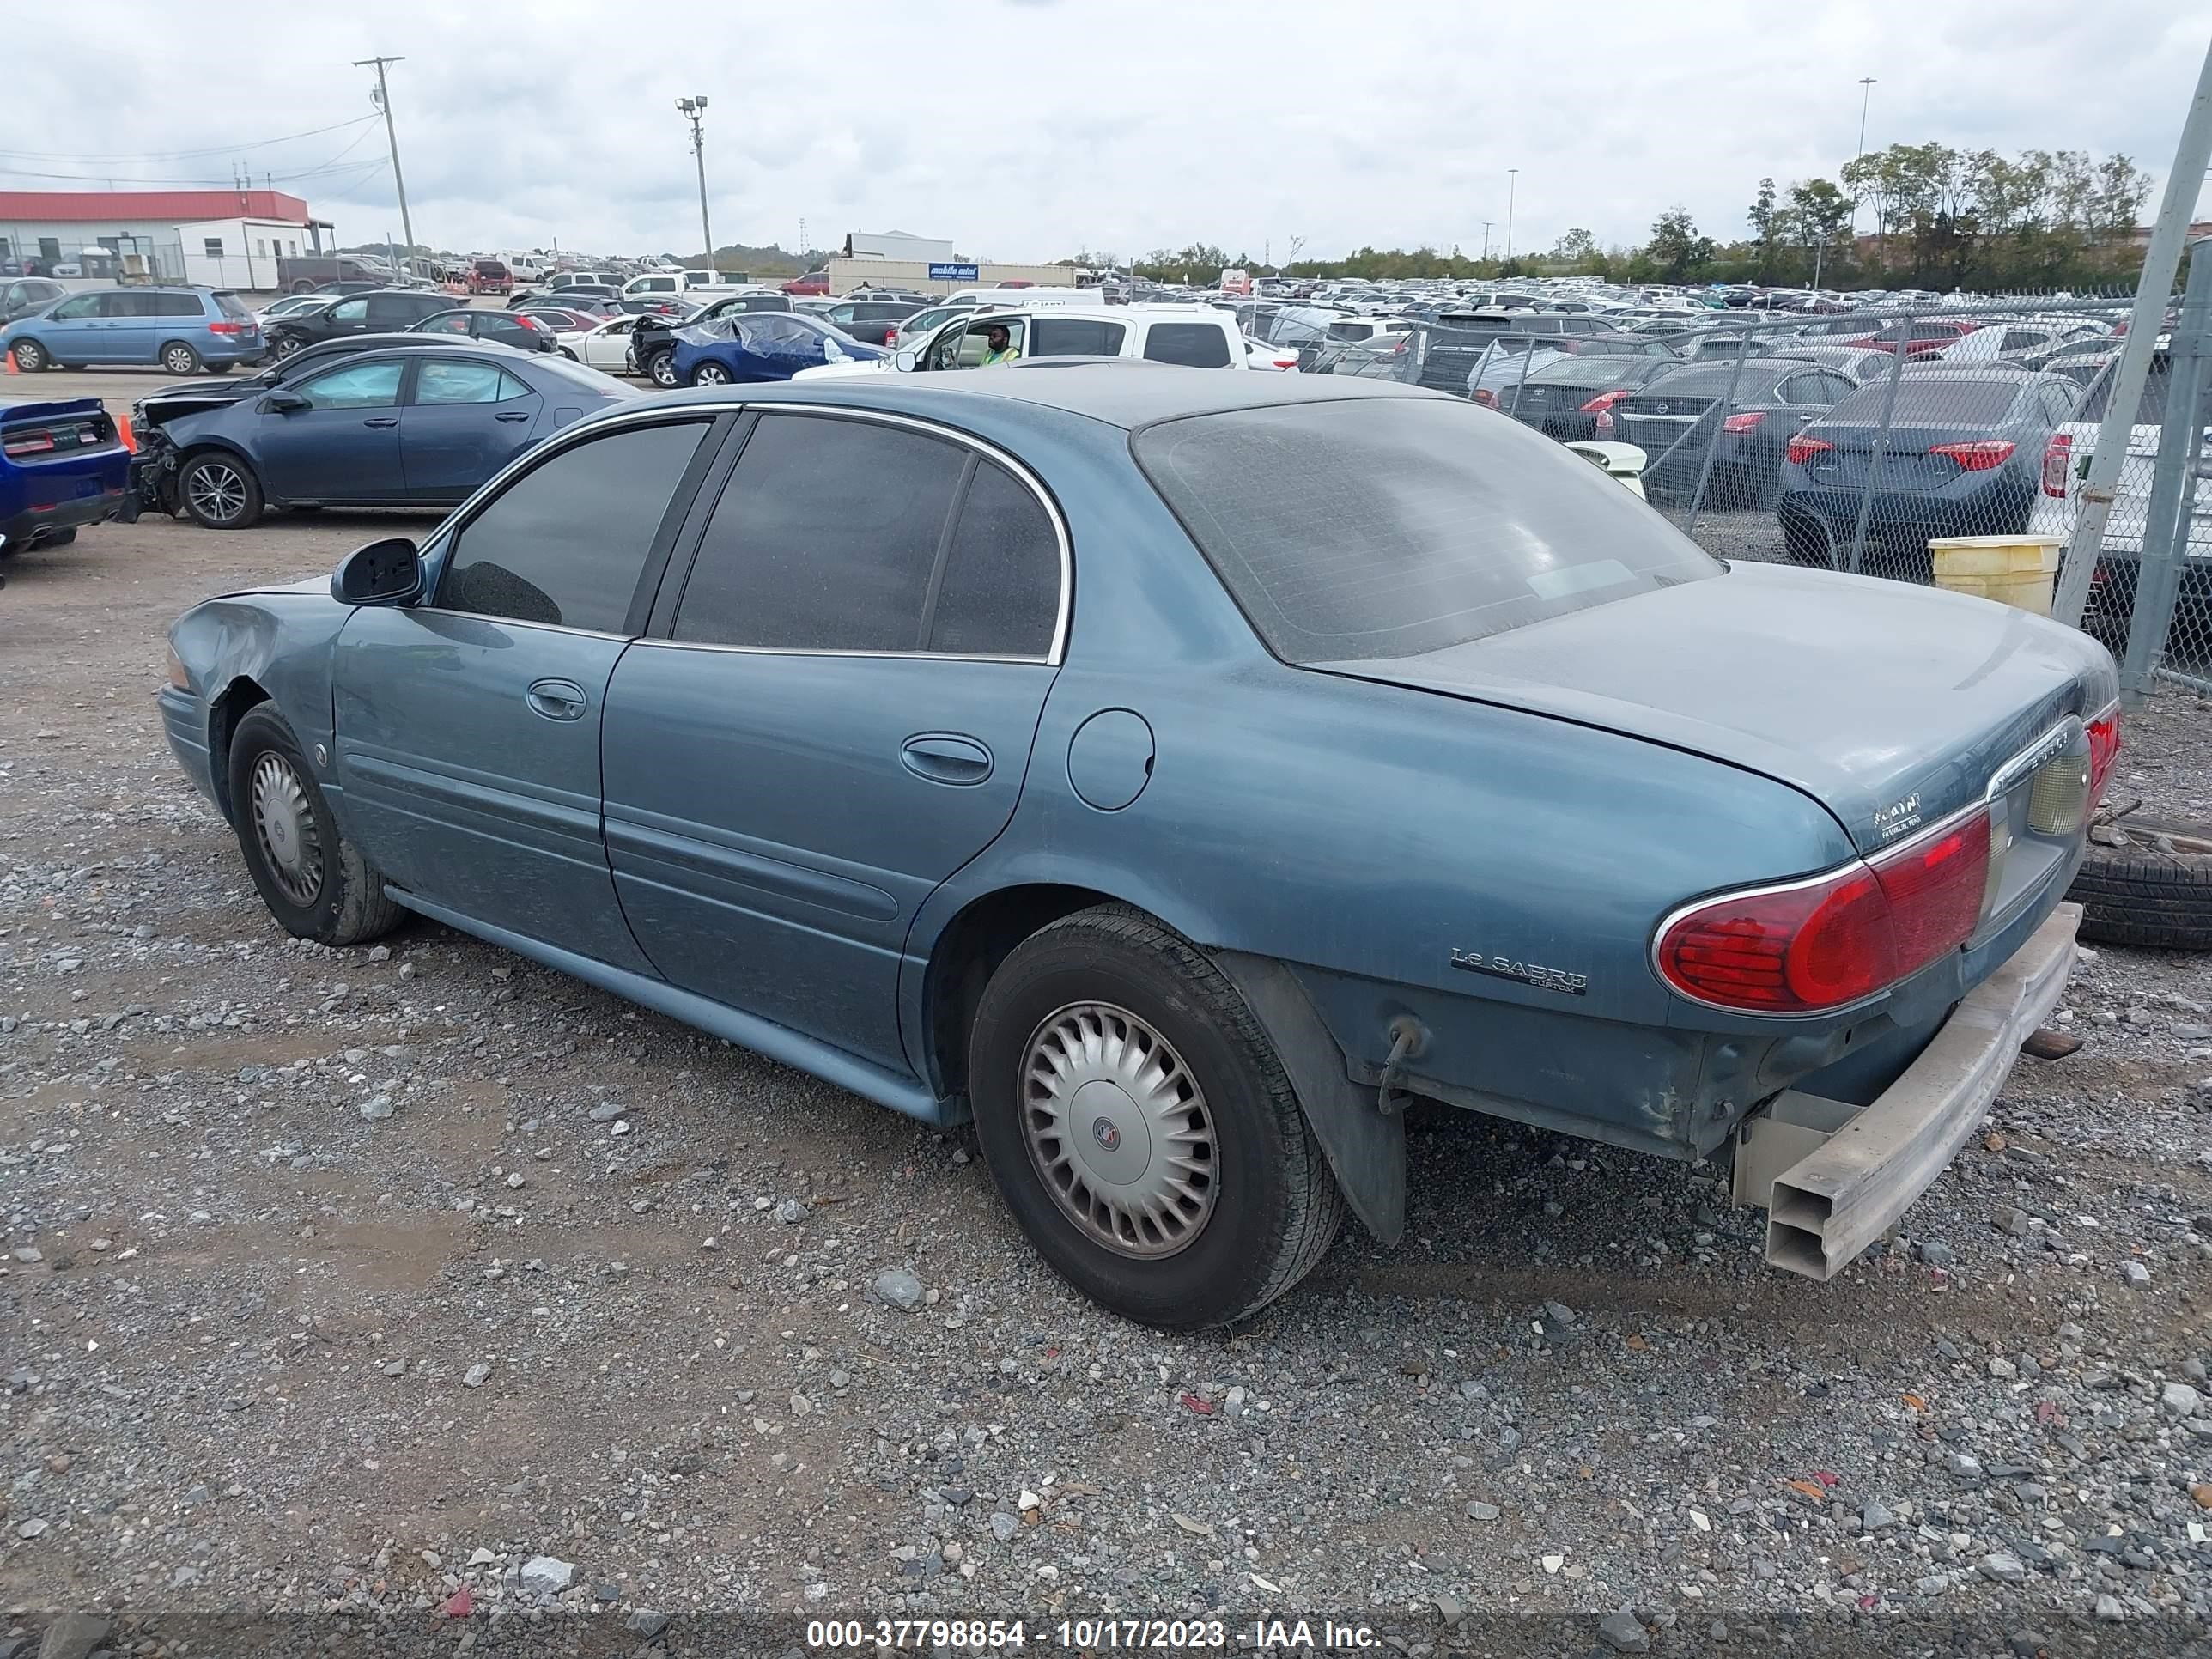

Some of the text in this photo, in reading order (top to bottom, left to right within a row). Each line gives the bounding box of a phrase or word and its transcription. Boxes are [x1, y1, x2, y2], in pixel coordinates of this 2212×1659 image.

[931, 265, 957, 275] mobile
[1492, 957, 1587, 988] SABRE
[1529, 978, 1575, 994] CUSTOM
